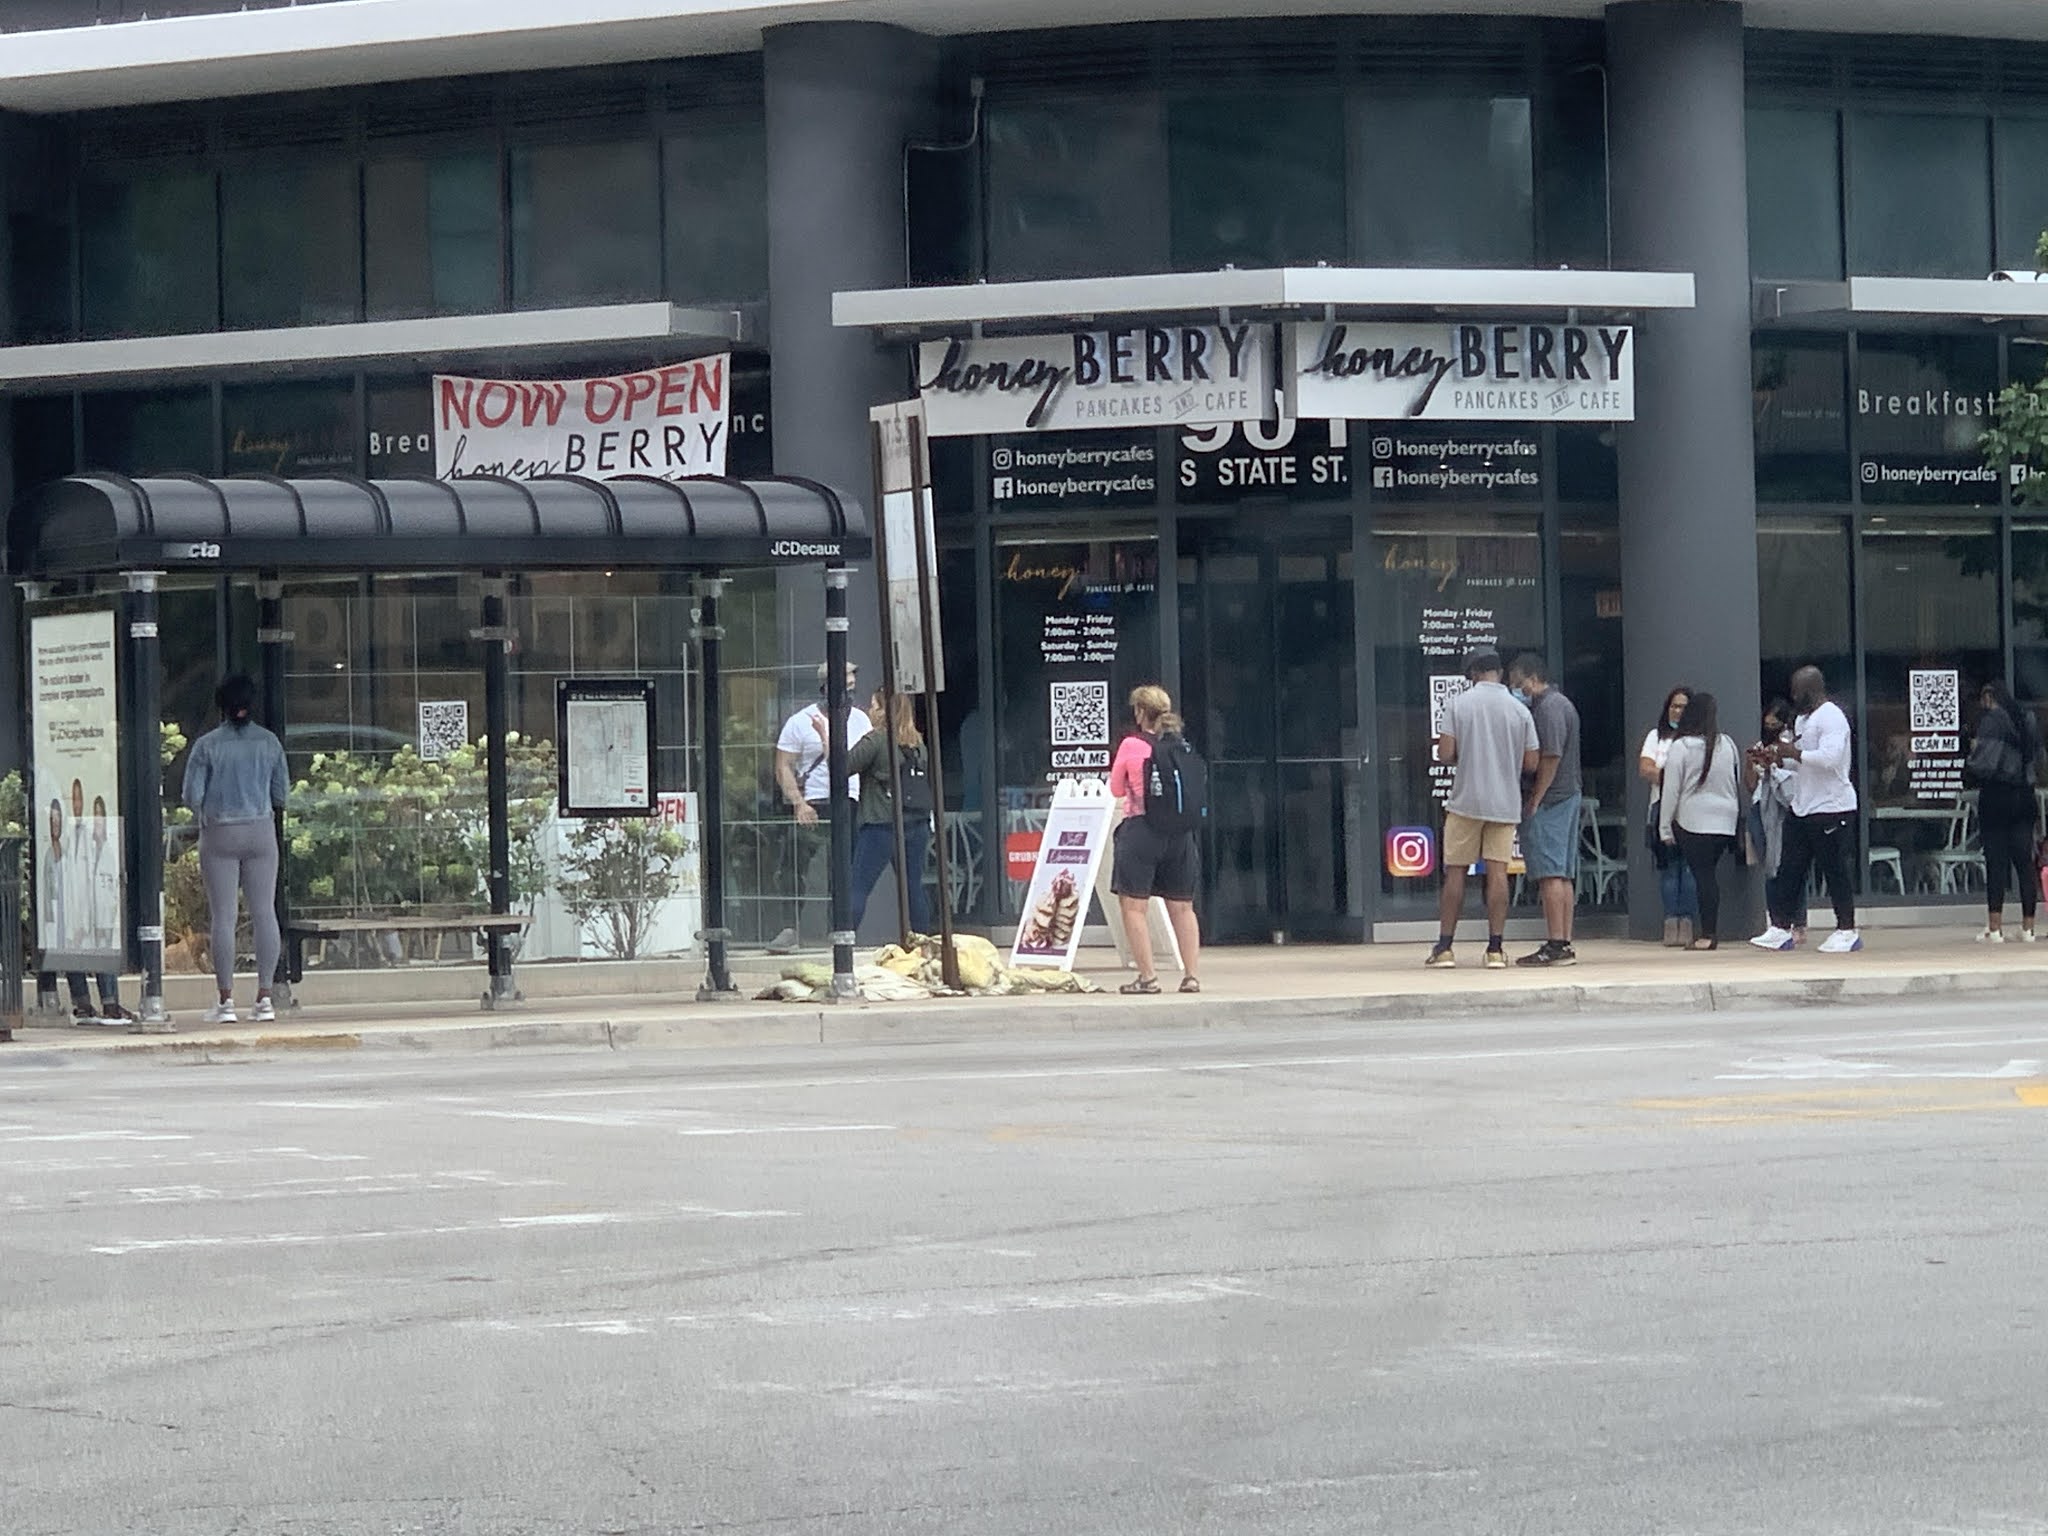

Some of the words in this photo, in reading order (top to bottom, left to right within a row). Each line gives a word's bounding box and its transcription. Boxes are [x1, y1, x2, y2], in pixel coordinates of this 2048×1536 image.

[920, 343, 1070, 427] honey
[1073, 326, 1248, 385] BERRY
[1304, 325, 1458, 416] honey
[1460, 326, 1628, 381] BERRY
[441, 379, 567, 431] NOW
[584, 358, 722, 425] OPEN
[1076, 395, 1162, 418] PANCAKES
[1205, 390, 1248, 411] CAFE
[1455, 390, 1538, 410] PANCAKES
[1551, 388, 1571, 411] AND
[1580, 391, 1621, 409] CAFE
[1858, 389, 1996, 416] Breakfast
[565, 421, 723, 473] BERRY
[1016, 447, 1155, 468] honeyberrycafes
[1397, 440, 1538, 460] honeyberrycafes
[1180, 459, 1197, 487] S
[1218, 457, 1297, 485] STATE
[1311, 455, 1348, 483] ST.
[1397, 467, 1539, 488] honeyberrycafes
[1881, 464, 1997, 485] honeyberrycafes
[1016, 478, 1155, 498] honeyberrycafes
[189, 541, 221, 558] cta
[771, 541, 840, 556] JCDecaux
[1002, 552, 1079, 600] honey
[1045, 616, 1079, 626] Monday
[1086, 615, 1113, 625] Friday
[1423, 609, 1458, 619] Monday
[1466, 608, 1493, 619] Friday
[1041, 641, 1079, 651] Saturday
[1086, 640, 1118, 650] Sunday
[1419, 634, 1458, 645] Saturday
[1466, 634, 1498, 644] Sunday
[1914, 738, 1939, 750] SCAN
[1942, 738, 1955, 750] ME
[1055, 754, 1085, 765] SCAN
[1089, 753, 1106, 764] ME
